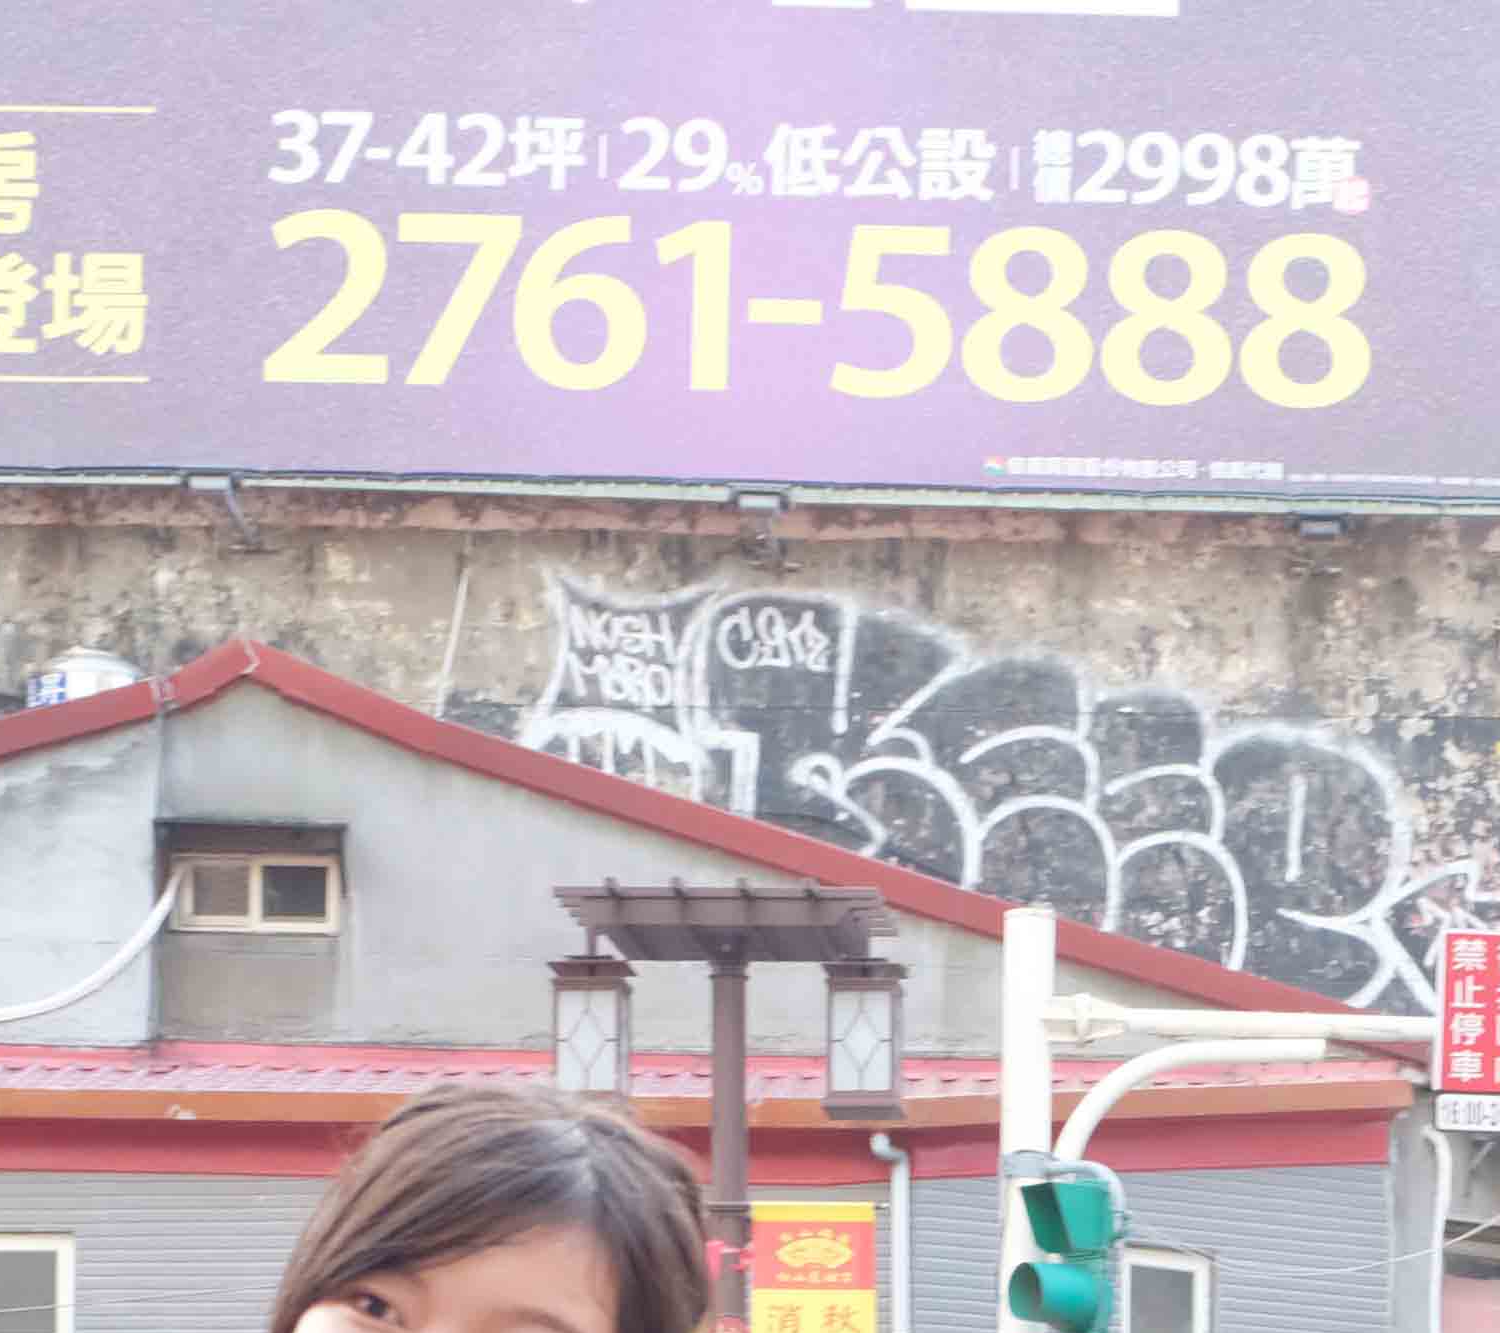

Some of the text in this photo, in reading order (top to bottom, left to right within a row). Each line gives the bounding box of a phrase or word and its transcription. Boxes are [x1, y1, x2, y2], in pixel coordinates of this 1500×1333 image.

[268, 110, 586, 192] 37-42坪
[617, 117, 997, 202] 29%低公設
[262, 208, 1372, 410] 2761-5888
[1449, 939, 1488, 1082] 禁止停車
